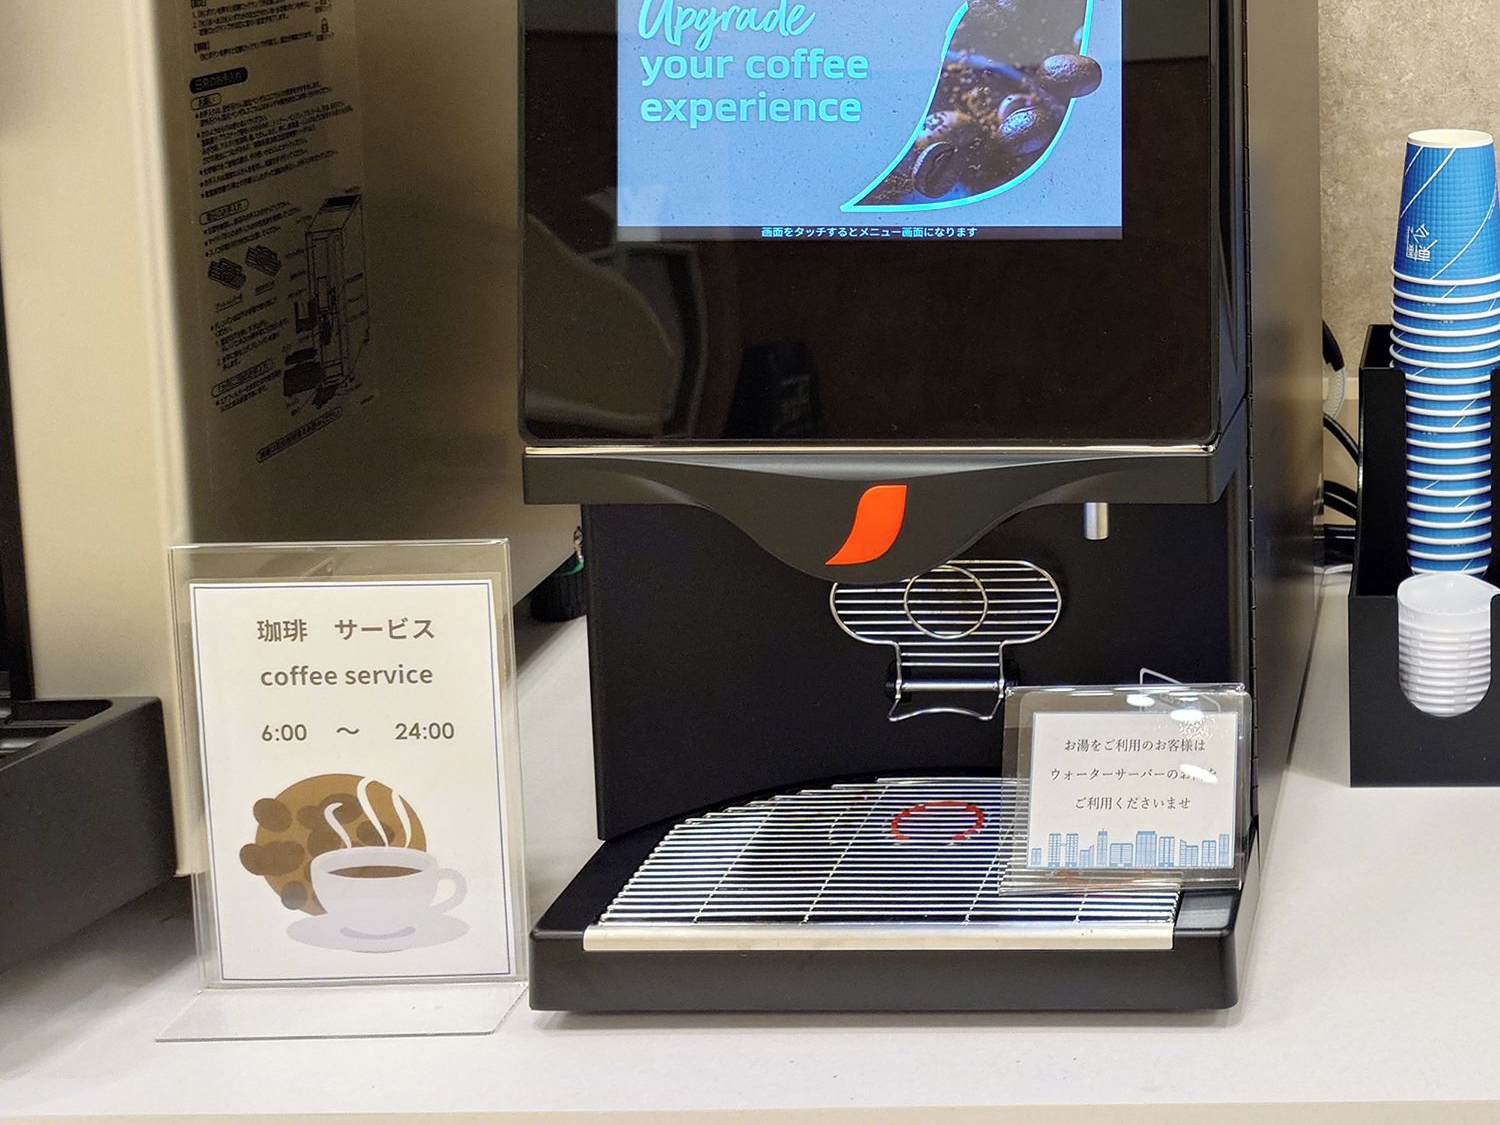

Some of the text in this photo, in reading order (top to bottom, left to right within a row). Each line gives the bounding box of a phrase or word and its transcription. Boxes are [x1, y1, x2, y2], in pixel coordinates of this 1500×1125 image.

[640, 48, 869, 87] your coffee
[640, 91, 862, 129] experience
[761, 226, 978, 238] 画面をタッチするとメニュー画面になります
[257, 617, 435, 642] 珈琲 サービス
[260, 663, 433, 686] coffee service
[261, 723, 308, 742] 6:00
[395, 722, 455, 740] 24:00
[1064, 738, 1206, 753] お湯をご利用のお客様は
[1075, 797, 1191, 810] ご利用くださいませ
